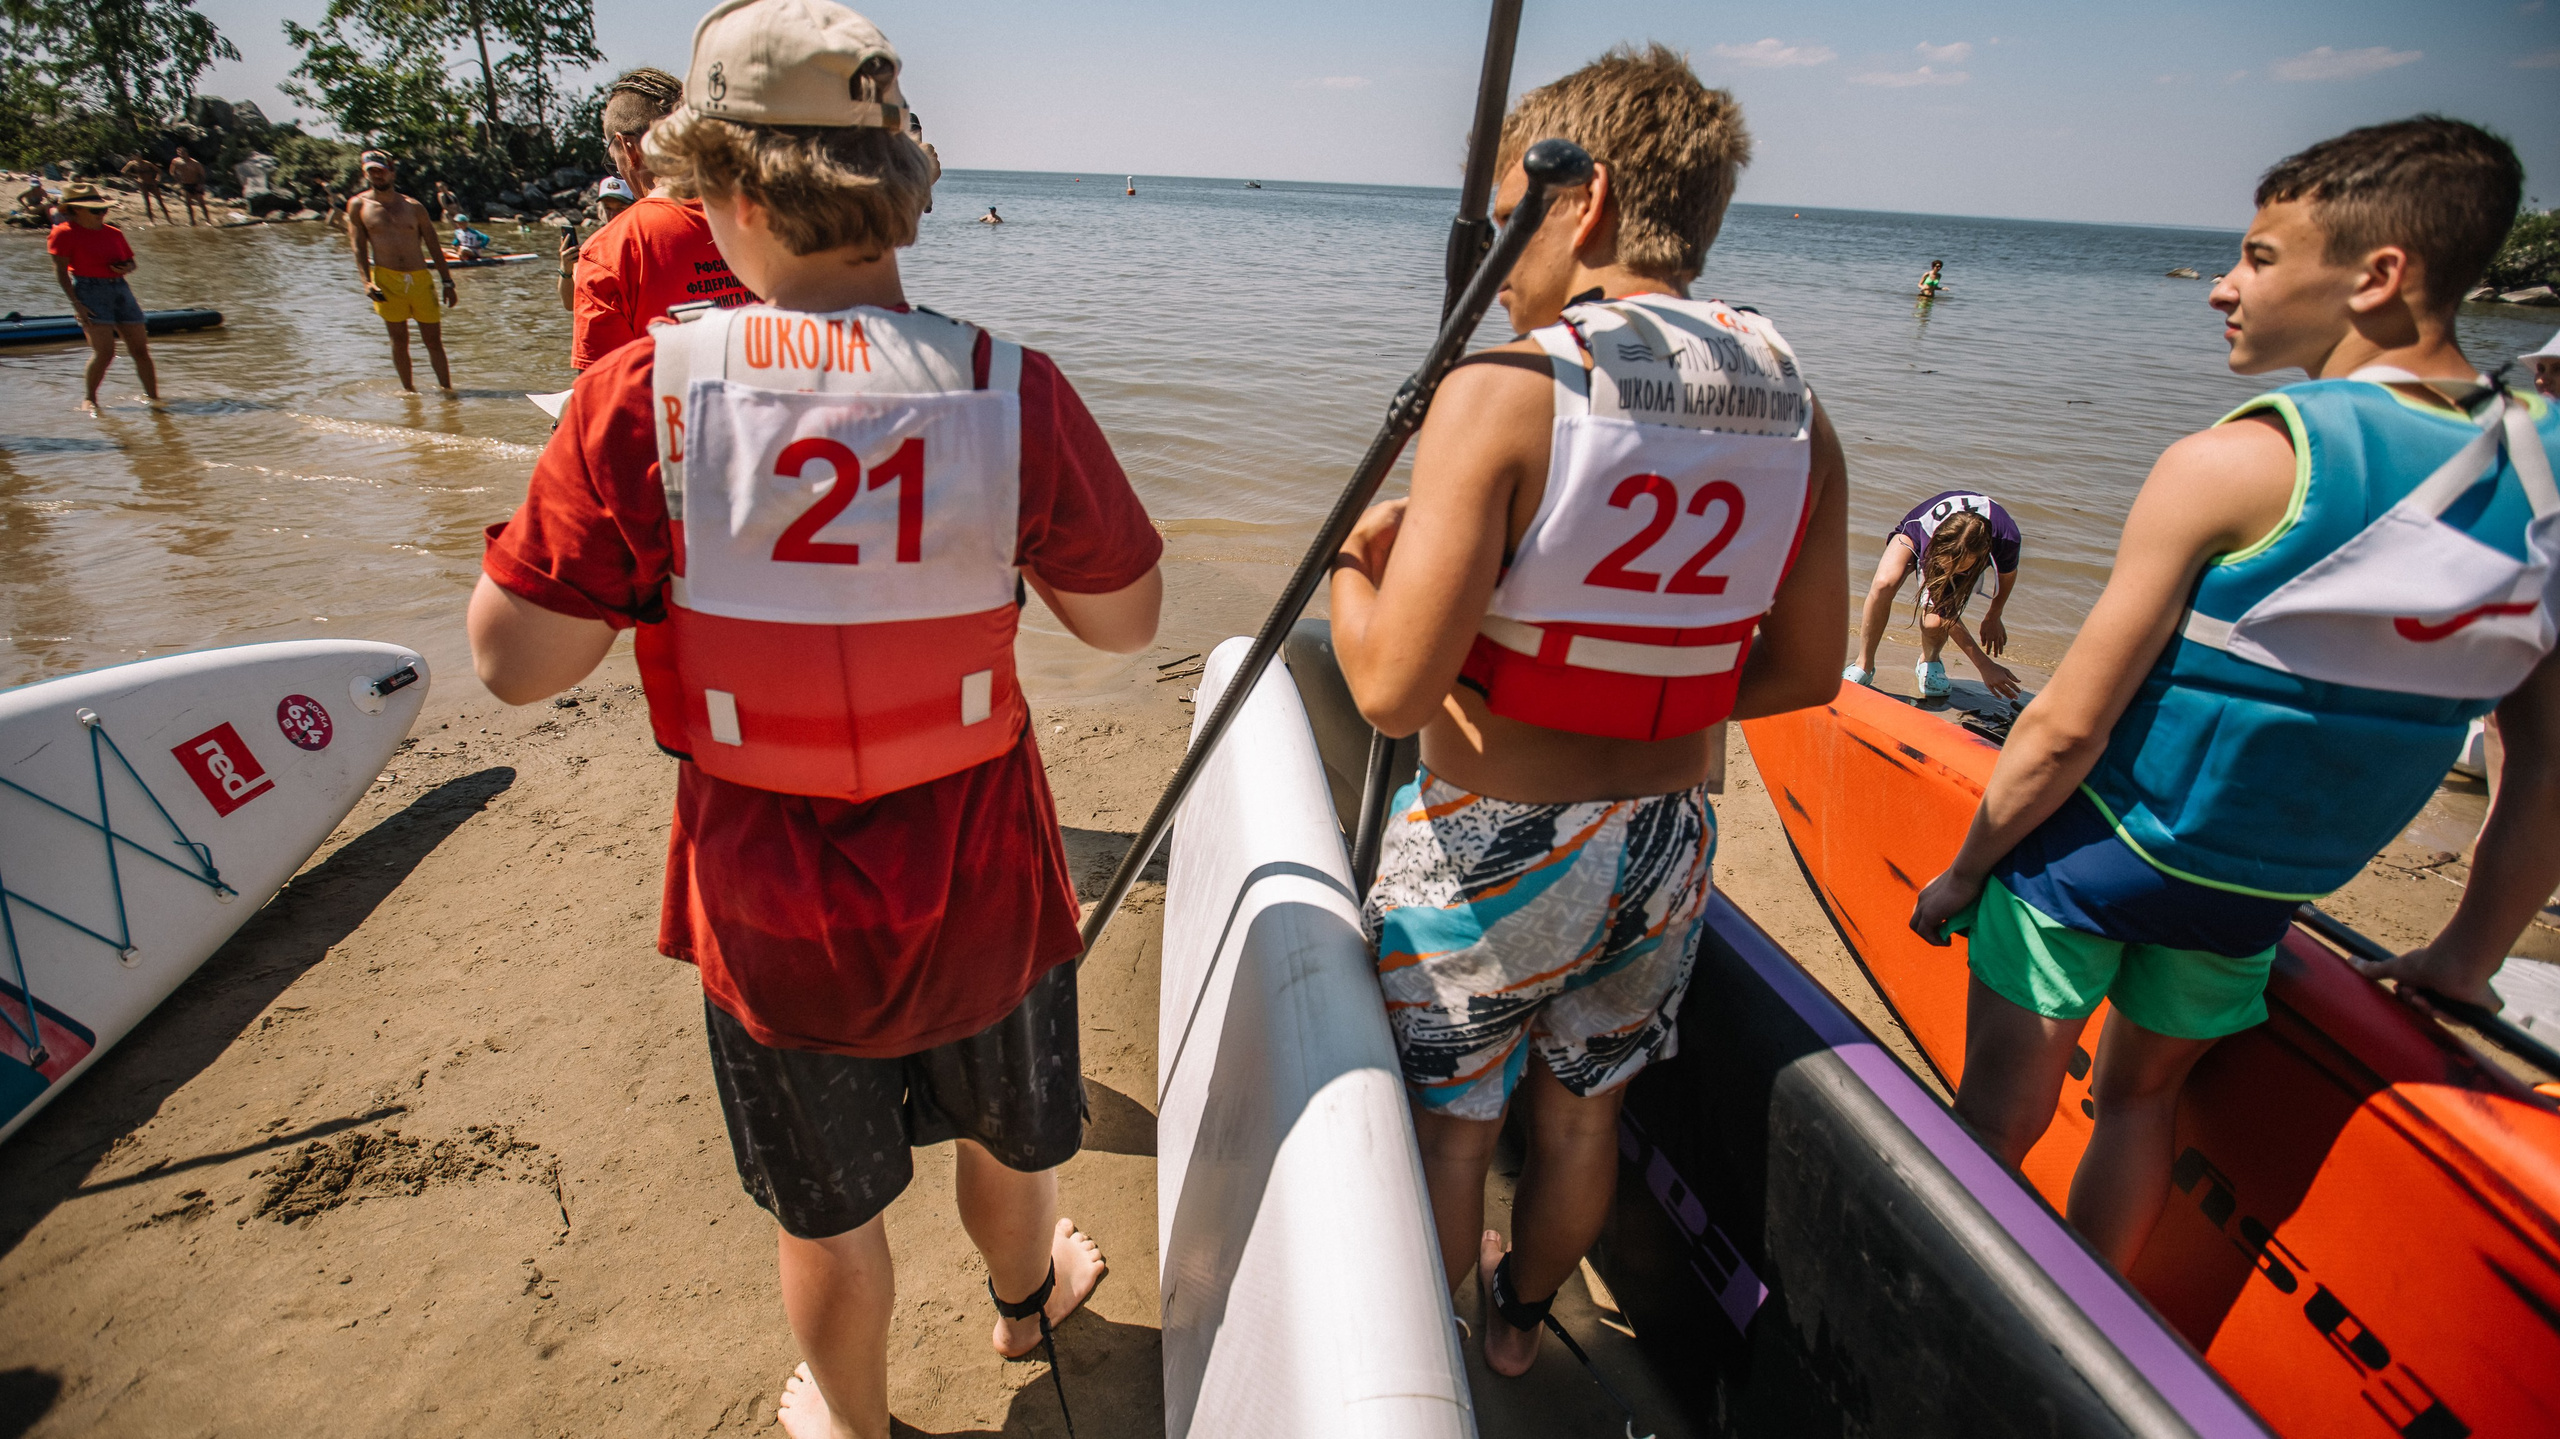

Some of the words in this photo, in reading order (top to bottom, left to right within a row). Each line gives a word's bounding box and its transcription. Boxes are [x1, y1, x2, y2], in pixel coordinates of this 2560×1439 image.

[744, 316, 872, 373] ШКОЛА
[1619, 377, 1675, 414] ШКОЛА
[1684, 382, 1768, 419] ПАРУСНОГО
[771, 436, 925, 566] 21
[1583, 473, 1746, 595] 22
[287, 704, 324, 744] 634
[194, 738, 270, 801] red
